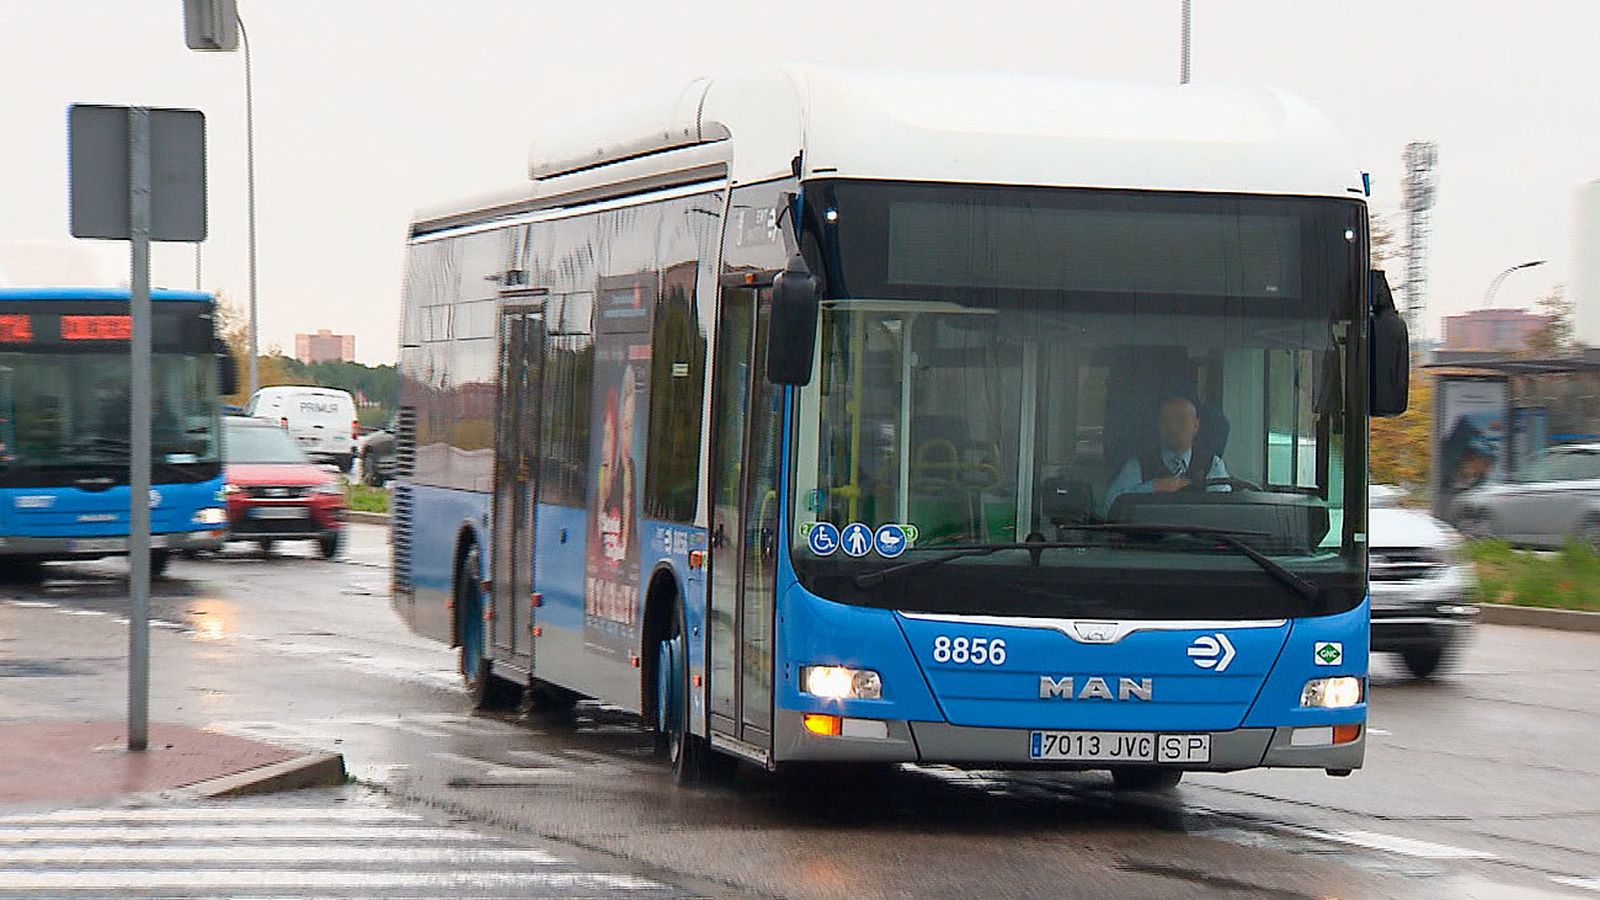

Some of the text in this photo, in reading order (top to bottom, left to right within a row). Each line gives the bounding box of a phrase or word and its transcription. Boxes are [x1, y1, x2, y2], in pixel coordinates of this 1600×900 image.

[933, 636, 1006, 665] 8856
[1320, 650, 1337, 658] GNC
[1039, 676, 1153, 701] MAN
[1045, 735, 1150, 757] 7013 JVC
